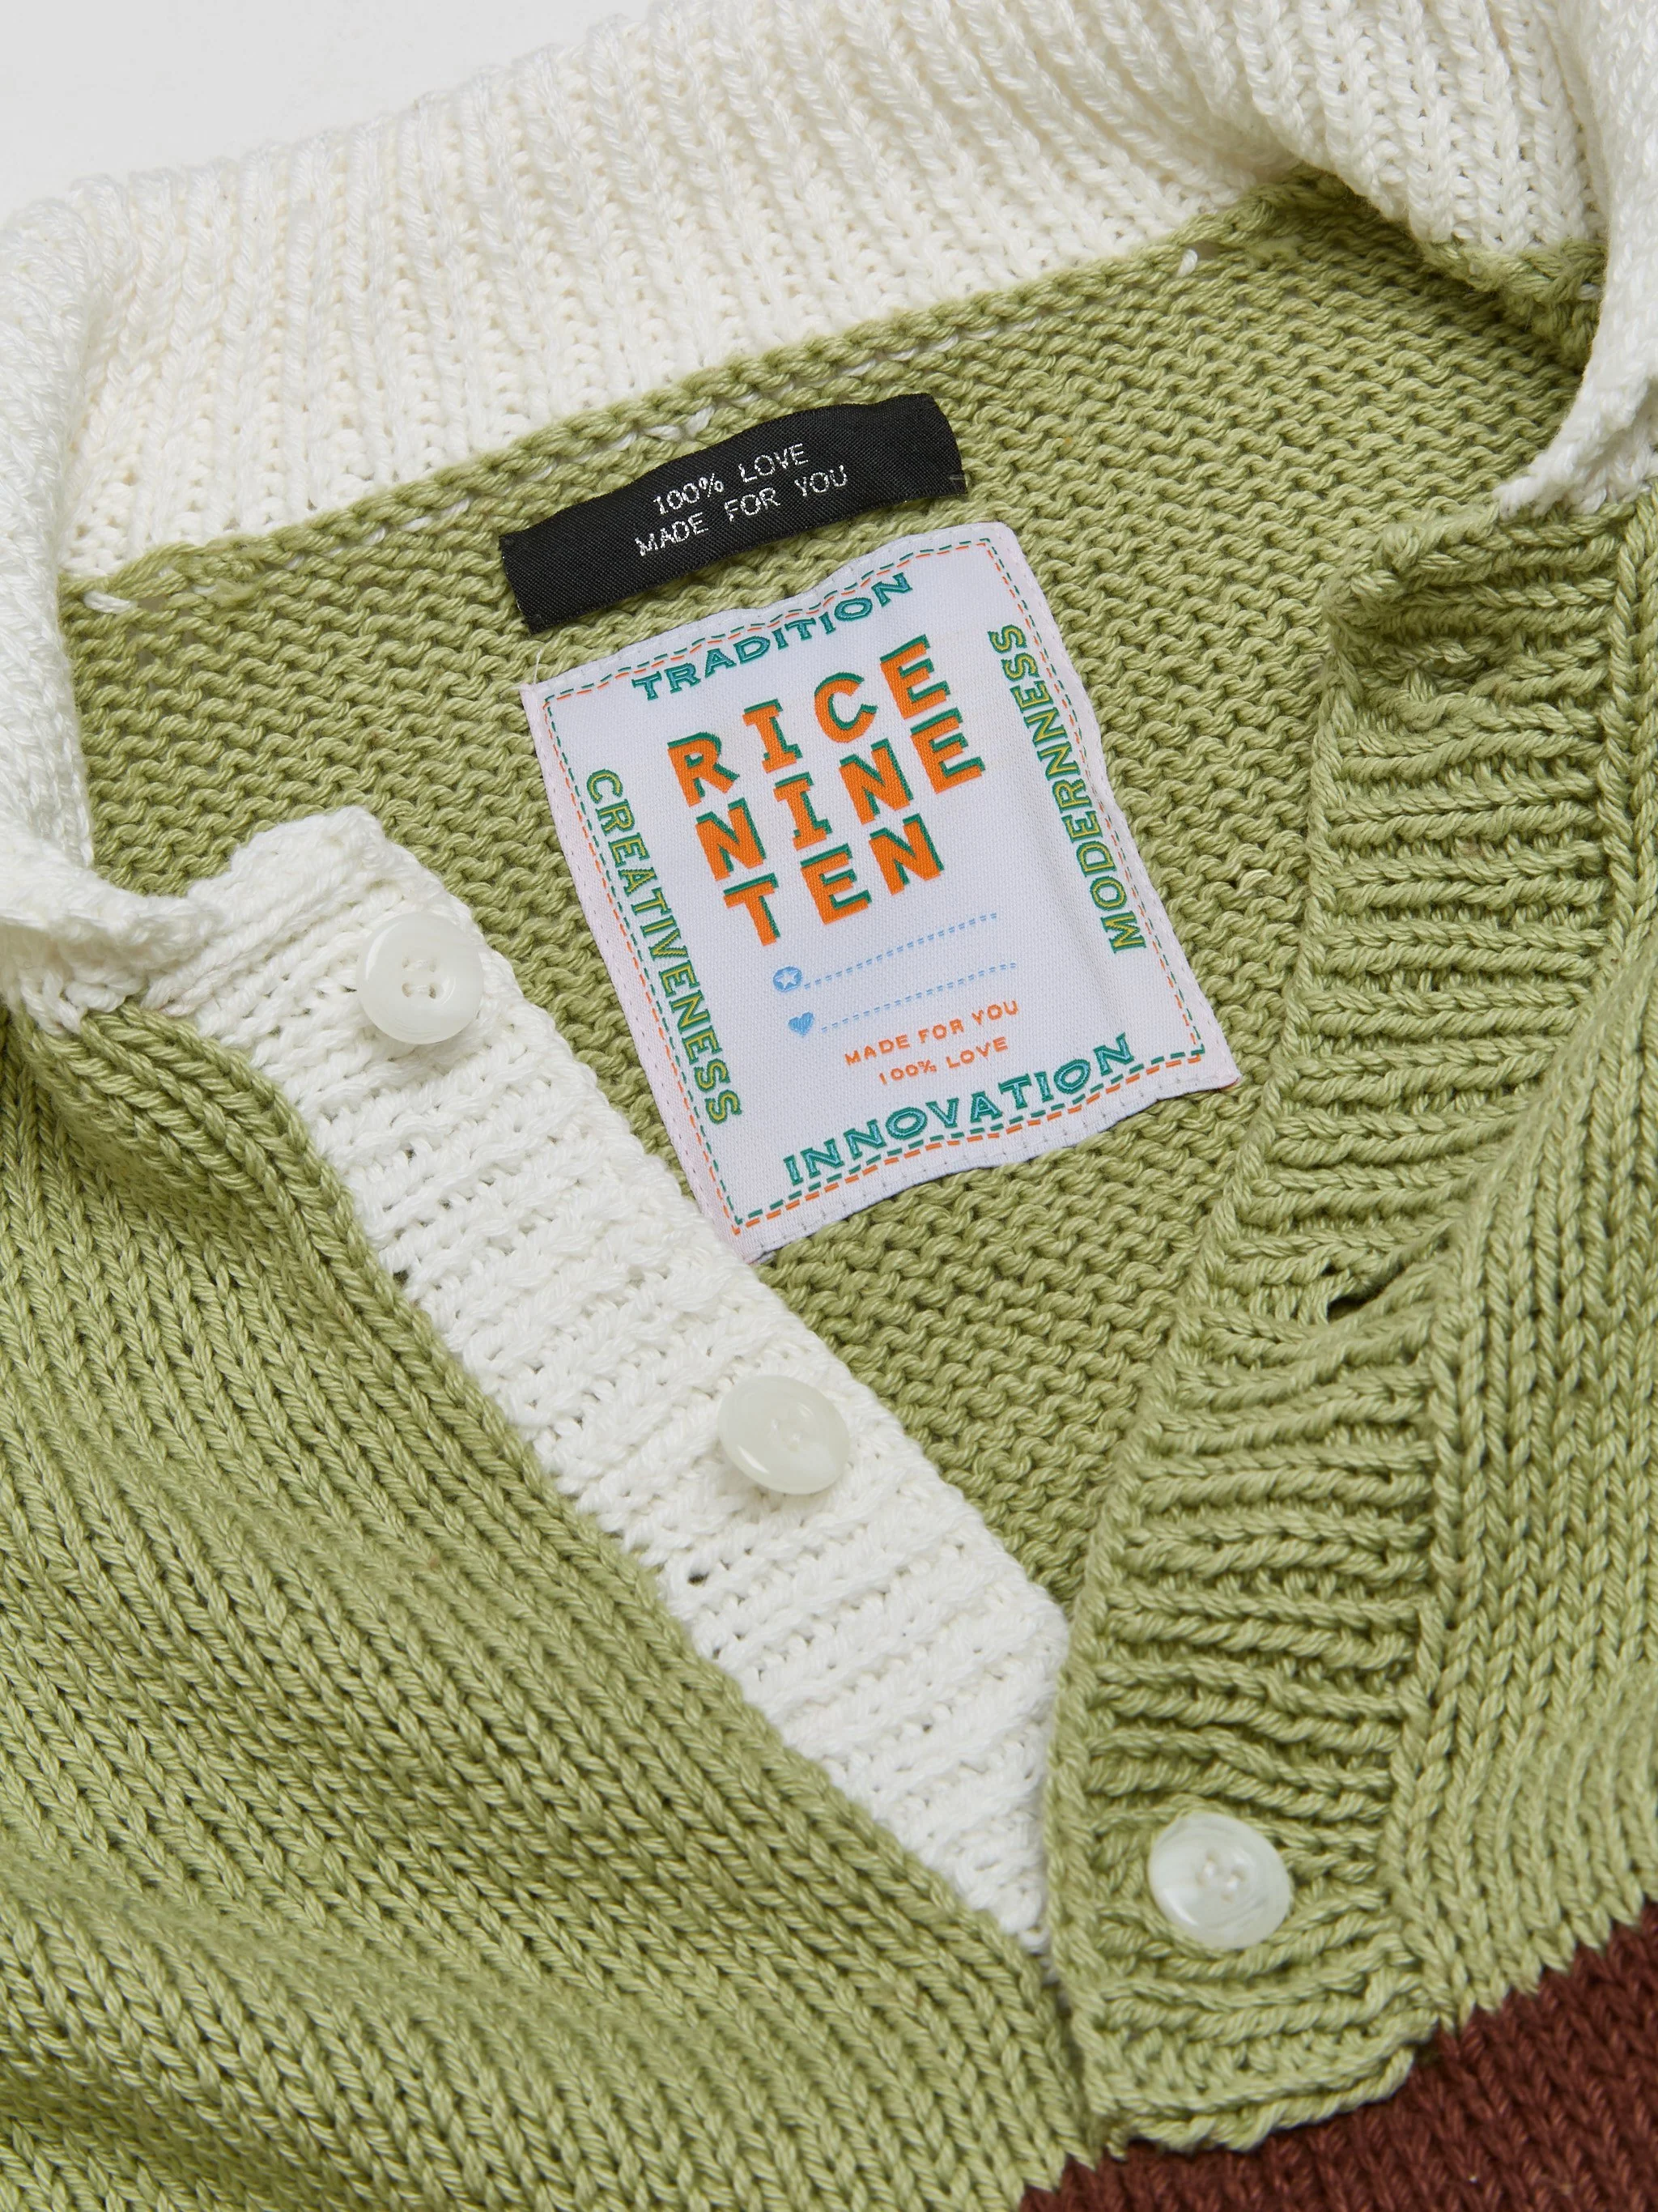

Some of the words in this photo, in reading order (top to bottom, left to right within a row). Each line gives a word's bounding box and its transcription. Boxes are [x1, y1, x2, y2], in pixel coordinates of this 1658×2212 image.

[635, 512, 708, 557] MADE
[725, 487, 780, 521] FOR
[794, 465, 847, 497] YOU
[653, 473, 724, 515] 100%
[738, 443, 809, 483] LOVE
[631, 572, 914, 701] TRADITION
[667, 633, 951, 807] RICE
[696, 707, 986, 881] NINE
[989, 623, 1147, 955] MODERNNESS
[724, 814, 945, 946] TEN
[585, 768, 743, 1126] CREATIVENESS
[844, 1034, 910, 1065] MADE
[918, 1018, 964, 1044] FOR
[971, 999, 1019, 1026] YOU
[878, 1059, 937, 1085] 100%
[946, 1036, 1009, 1069] LOVE
[783, 1032, 1136, 1186] INNOVATION
